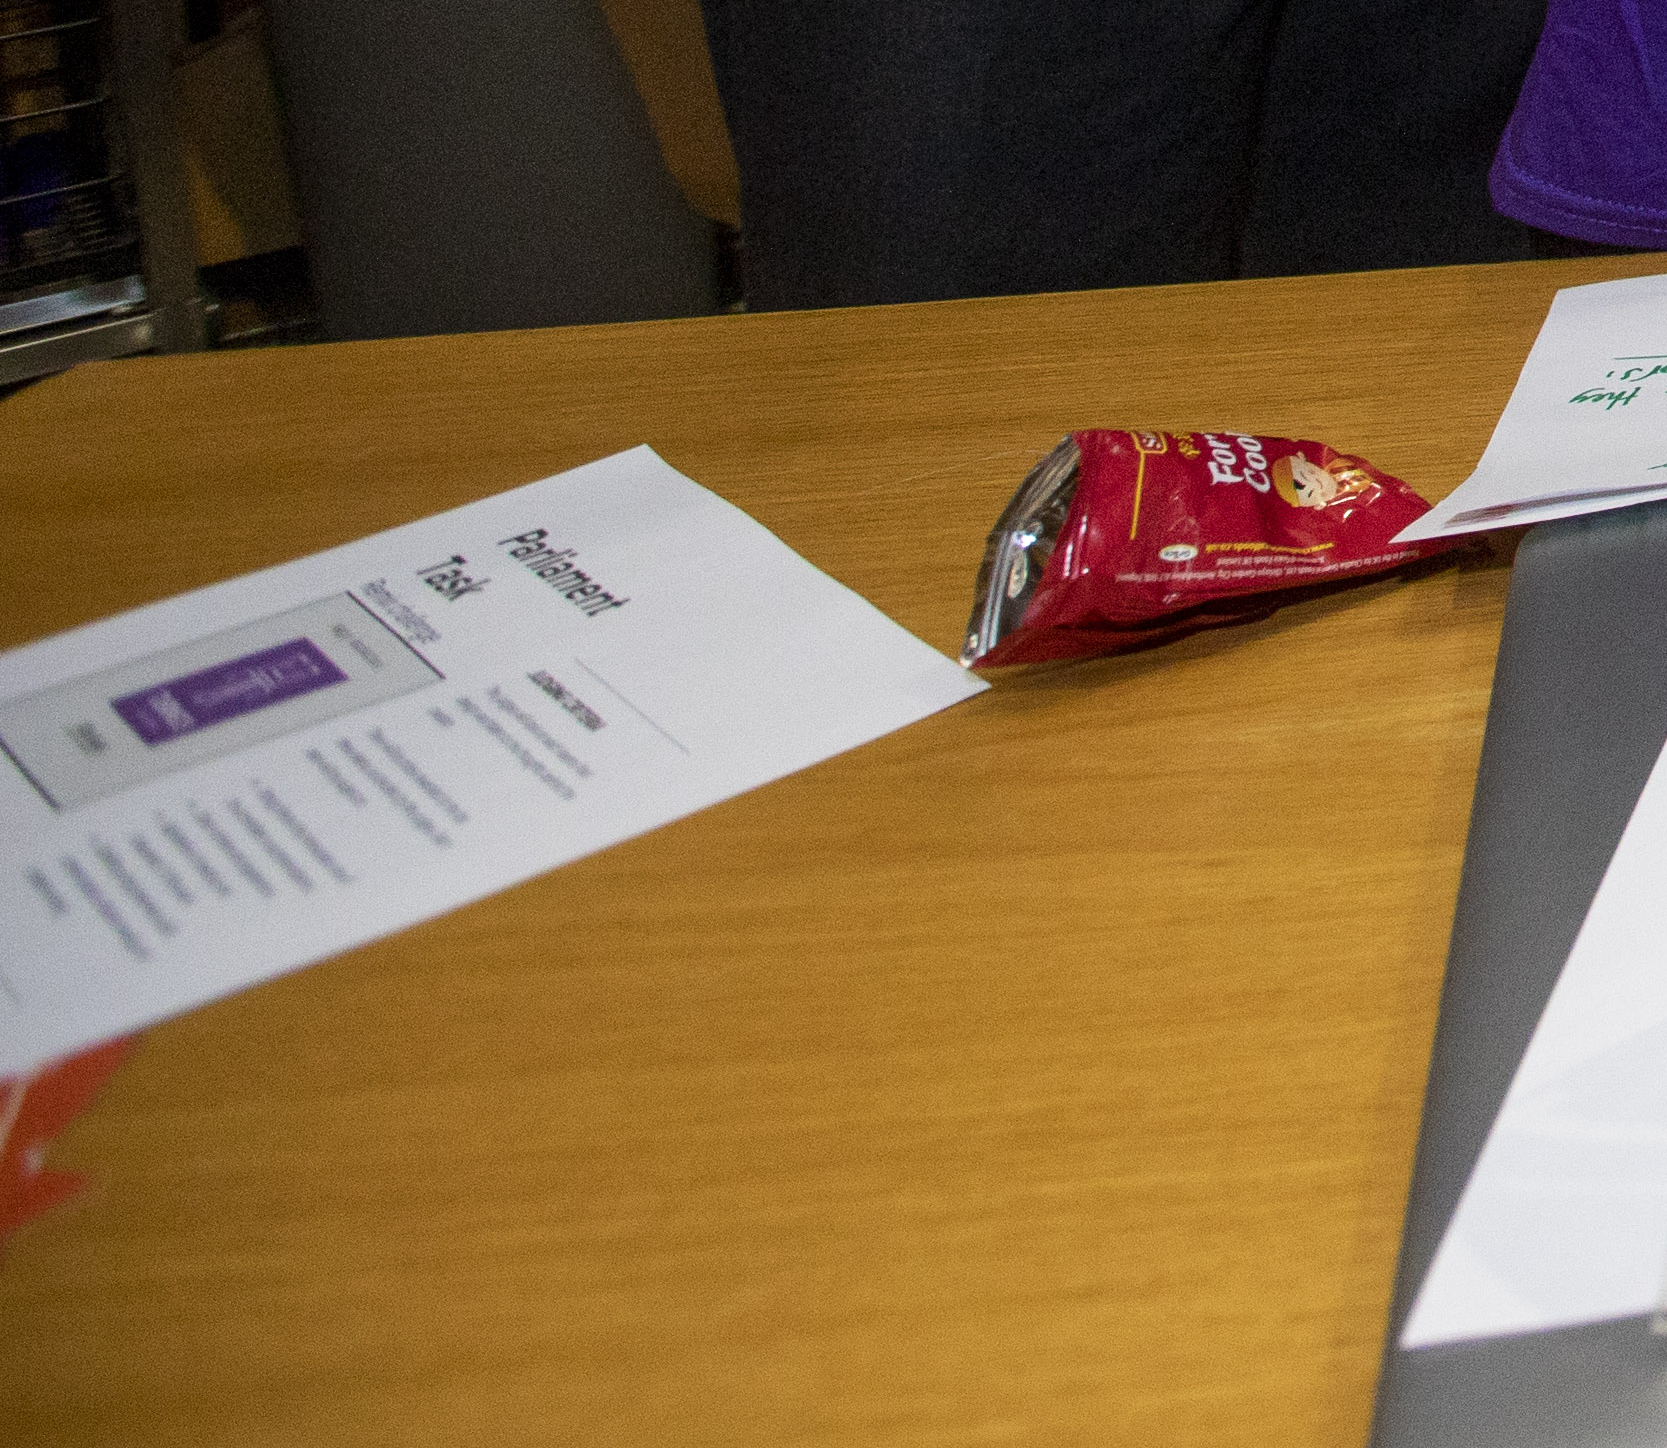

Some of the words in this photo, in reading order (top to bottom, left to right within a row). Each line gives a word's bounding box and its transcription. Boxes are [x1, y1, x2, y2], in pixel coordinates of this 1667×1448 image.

[1567, 385, 1641, 411] they
[415, 553, 493, 602] Task
[496, 527, 631, 618] Parliament
